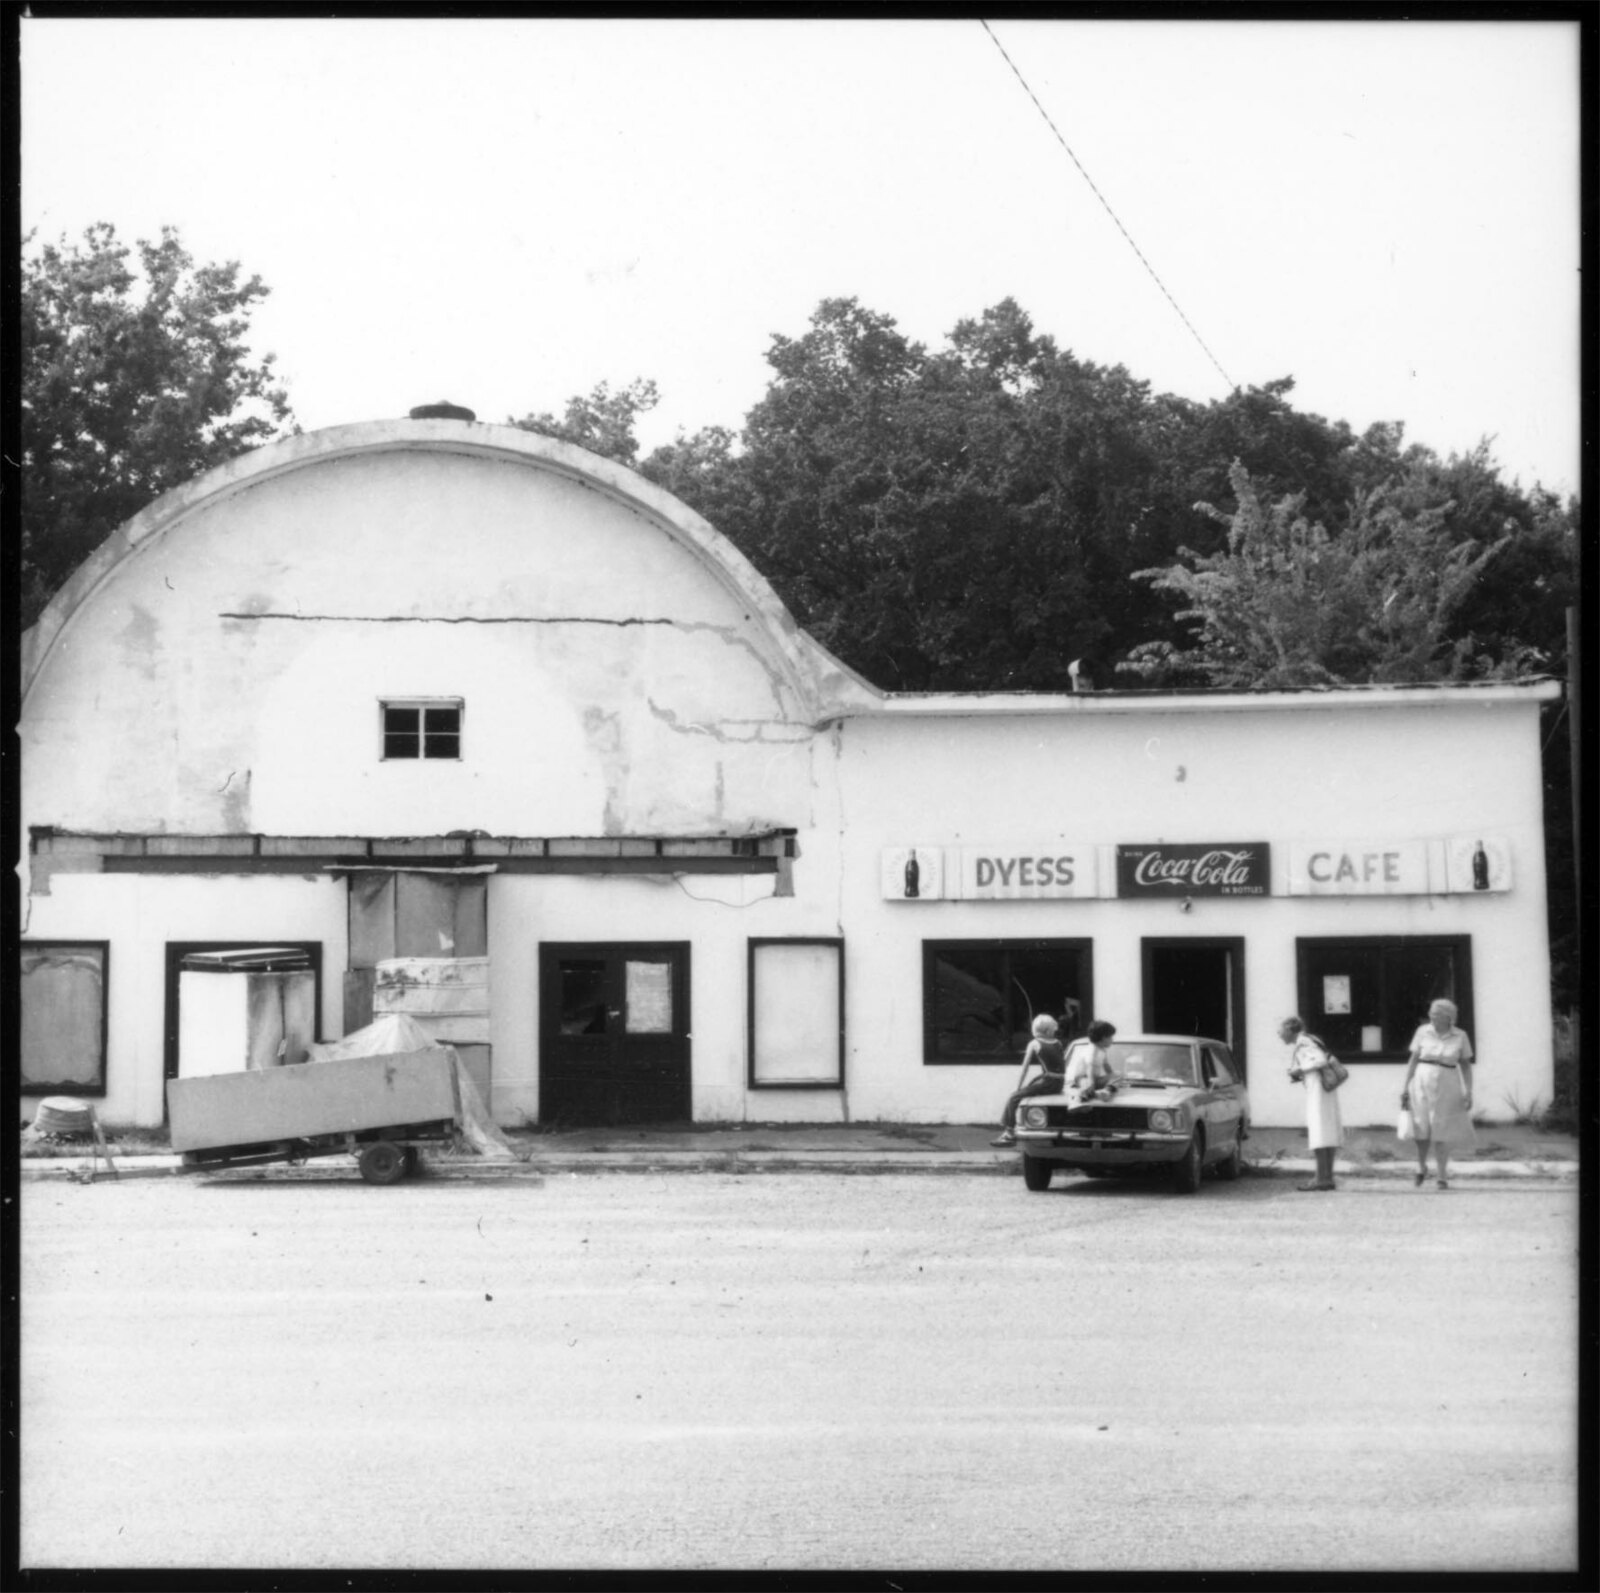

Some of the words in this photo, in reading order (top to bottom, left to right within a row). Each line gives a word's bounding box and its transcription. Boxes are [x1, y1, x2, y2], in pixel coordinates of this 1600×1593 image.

[976, 857, 1074, 887] DYESS
[1135, 851, 1255, 885] Coca-Cola
[1307, 852, 1400, 882] CAFE
